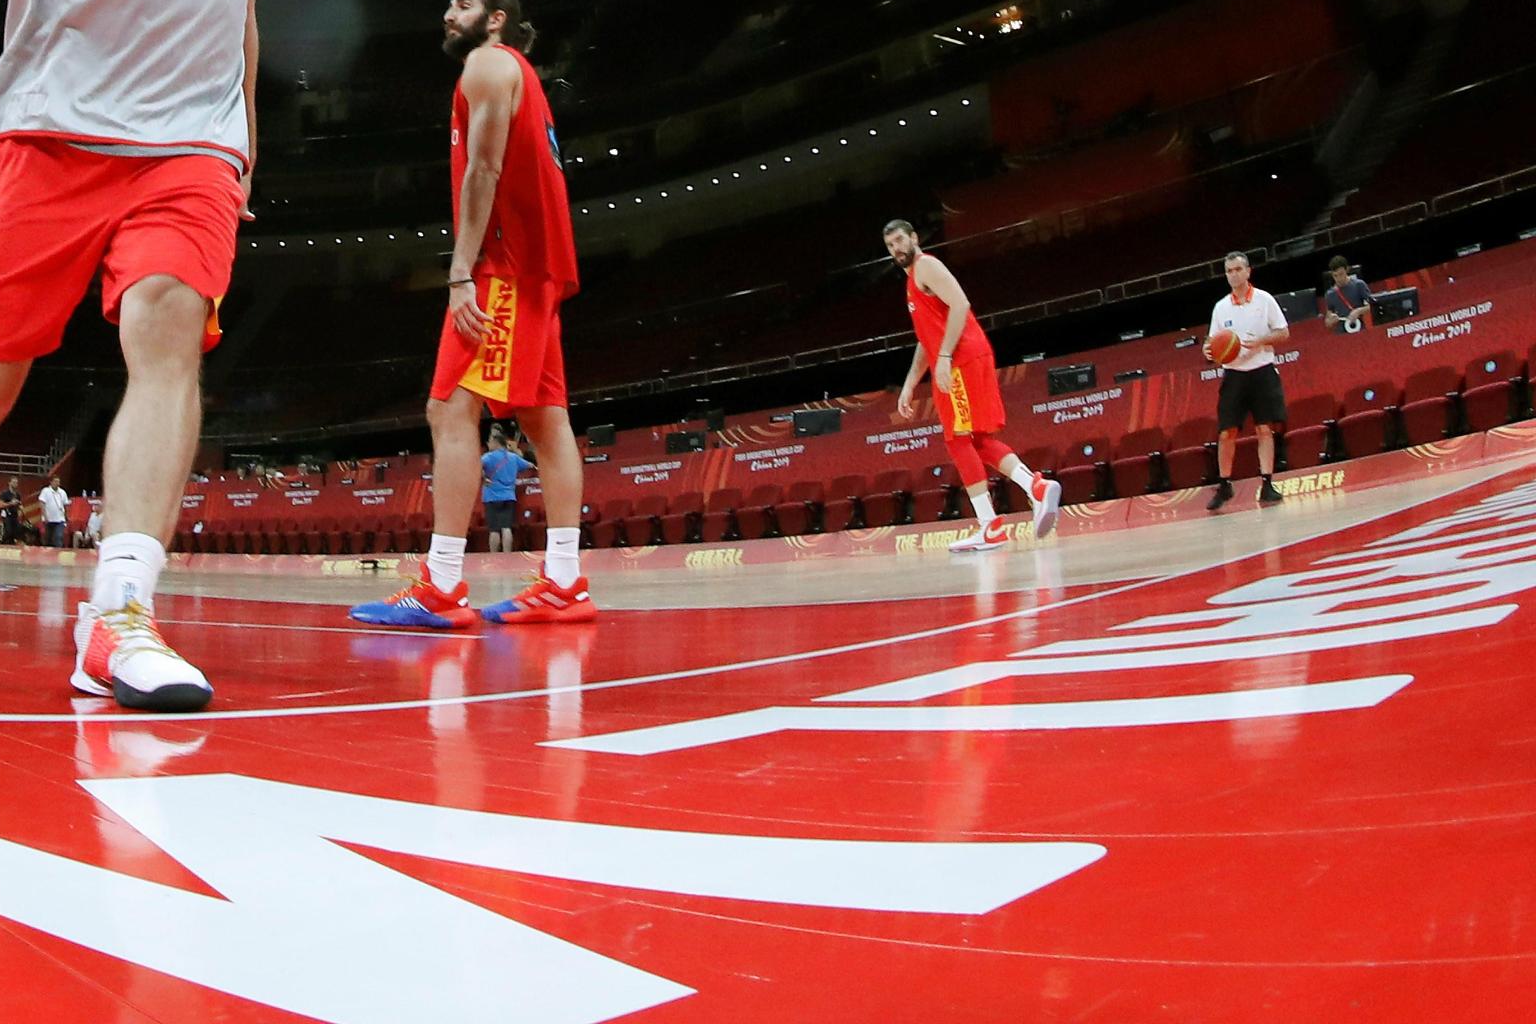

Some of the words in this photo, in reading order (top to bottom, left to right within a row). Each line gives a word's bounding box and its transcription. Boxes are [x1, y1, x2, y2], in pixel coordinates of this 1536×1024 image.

[1404, 313, 1451, 335] BASKETBALL
[1450, 305, 1477, 324] WORLD
[1477, 301, 1493, 315] CUP
[1413, 332, 1445, 348] China
[1446, 321, 1472, 339] 2019
[895, 534, 920, 553] THE
